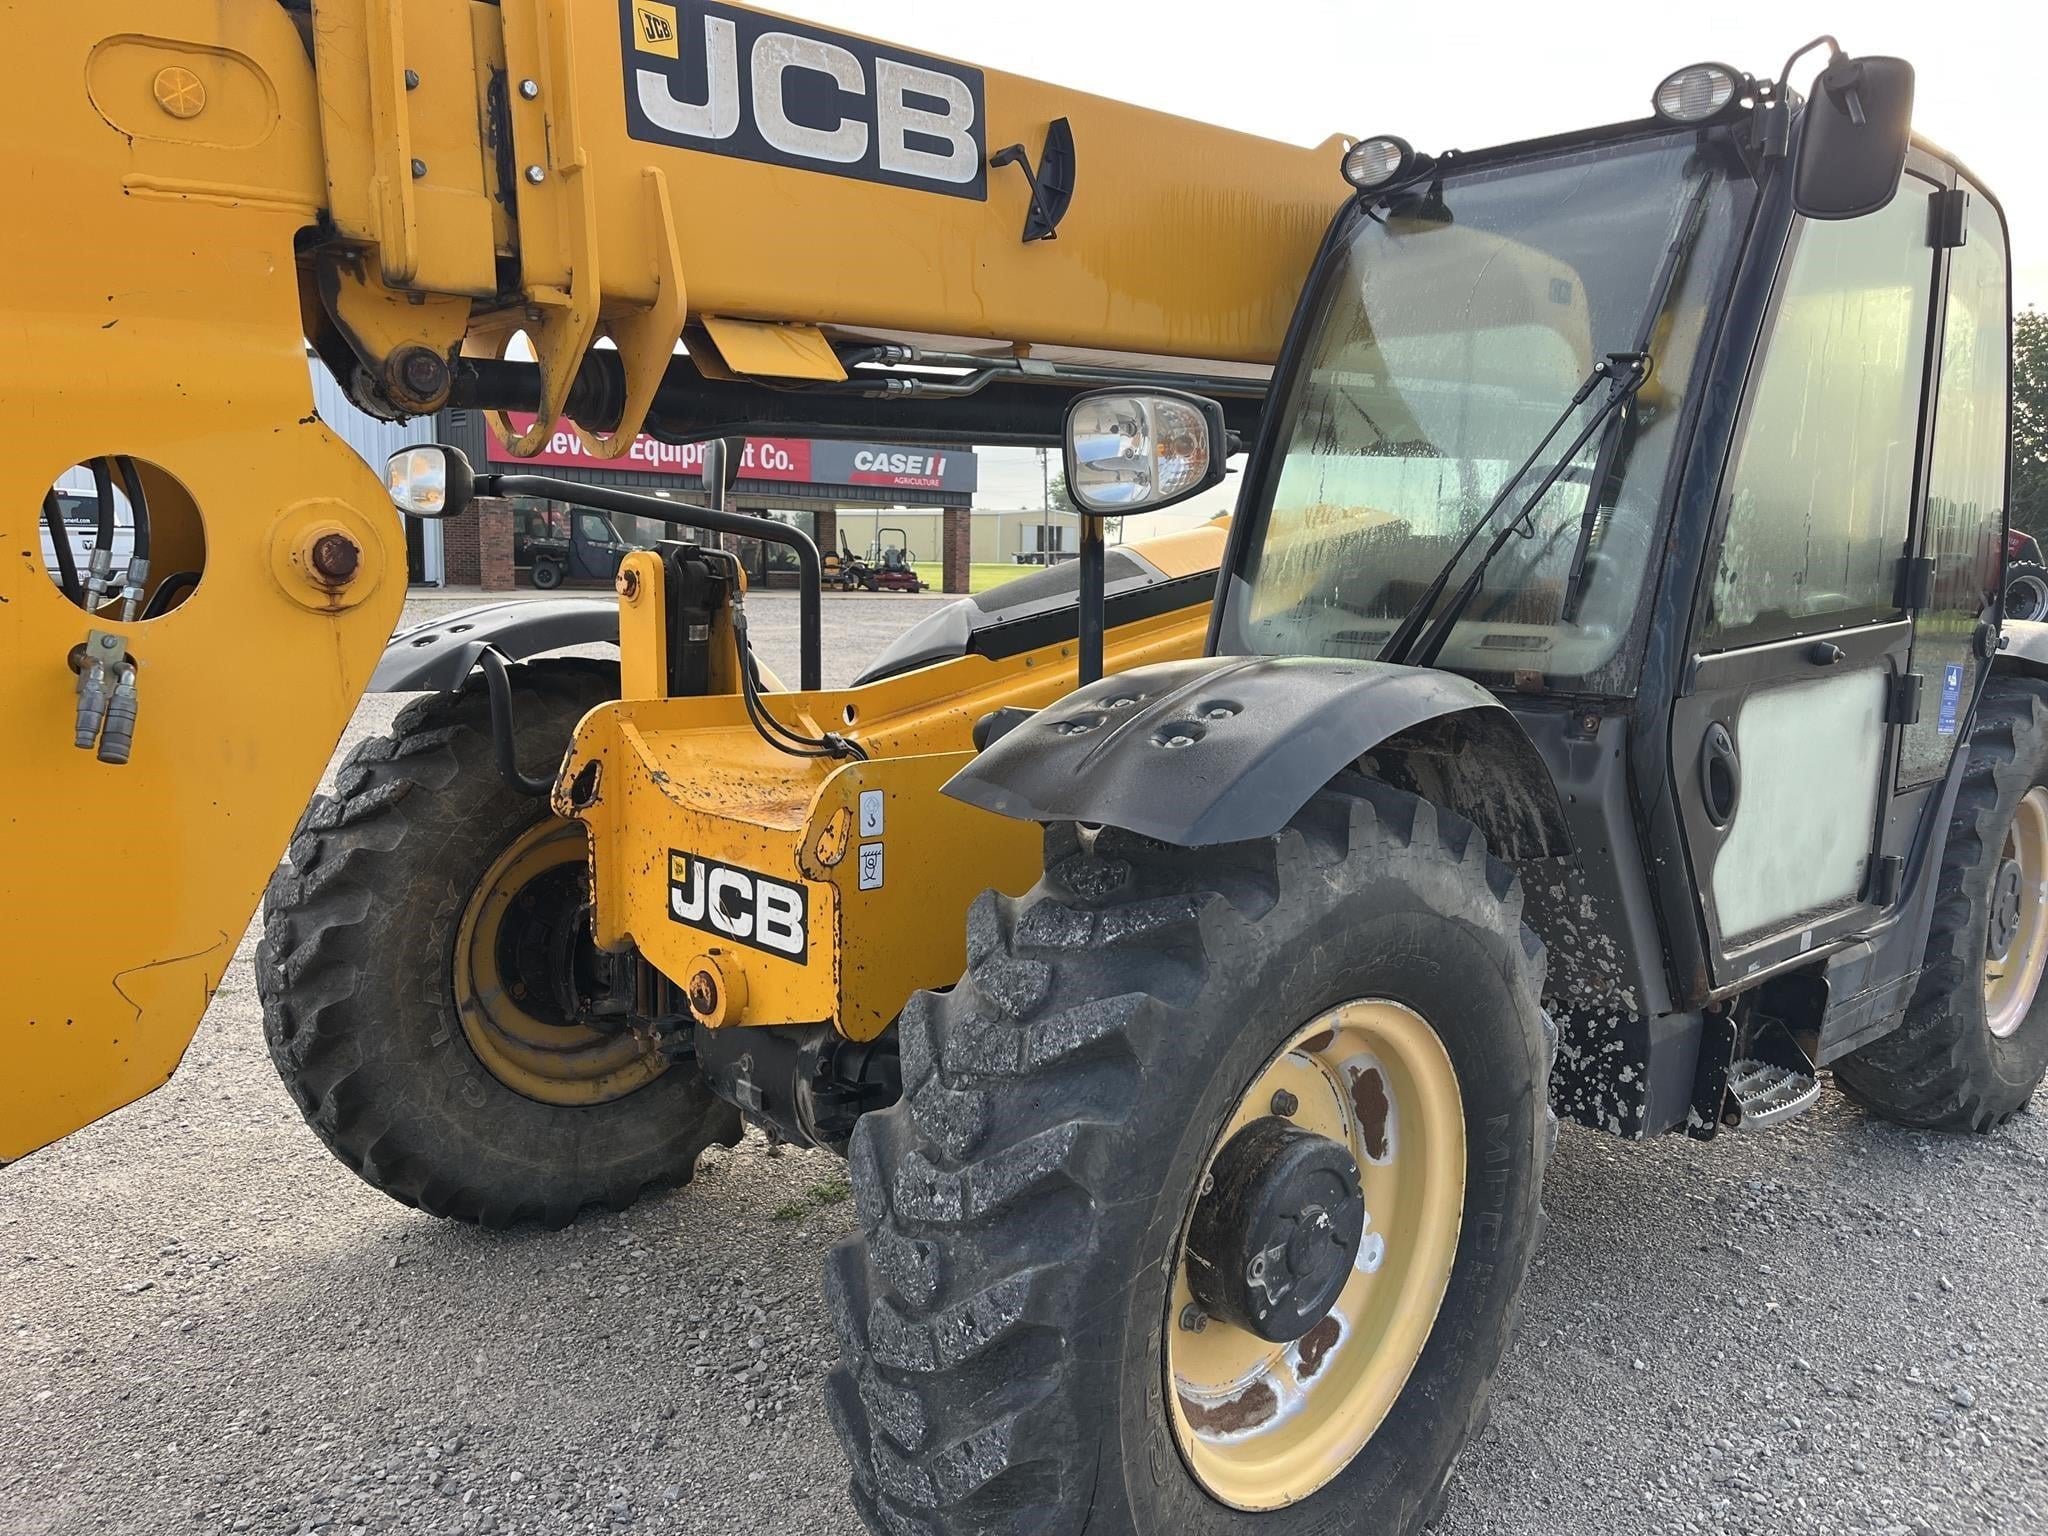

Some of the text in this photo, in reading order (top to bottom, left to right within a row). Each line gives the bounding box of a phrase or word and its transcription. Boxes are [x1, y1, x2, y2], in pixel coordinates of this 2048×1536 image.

[644, 13, 673, 41] JCB
[636, 14, 979, 184] JCB
[629, 433, 754, 469] Equipt
[760, 443, 794, 471] Co.
[854, 450, 922, 475] CASE
[893, 476, 940, 488] AGRICULTURE
[671, 860, 805, 955] JCB
